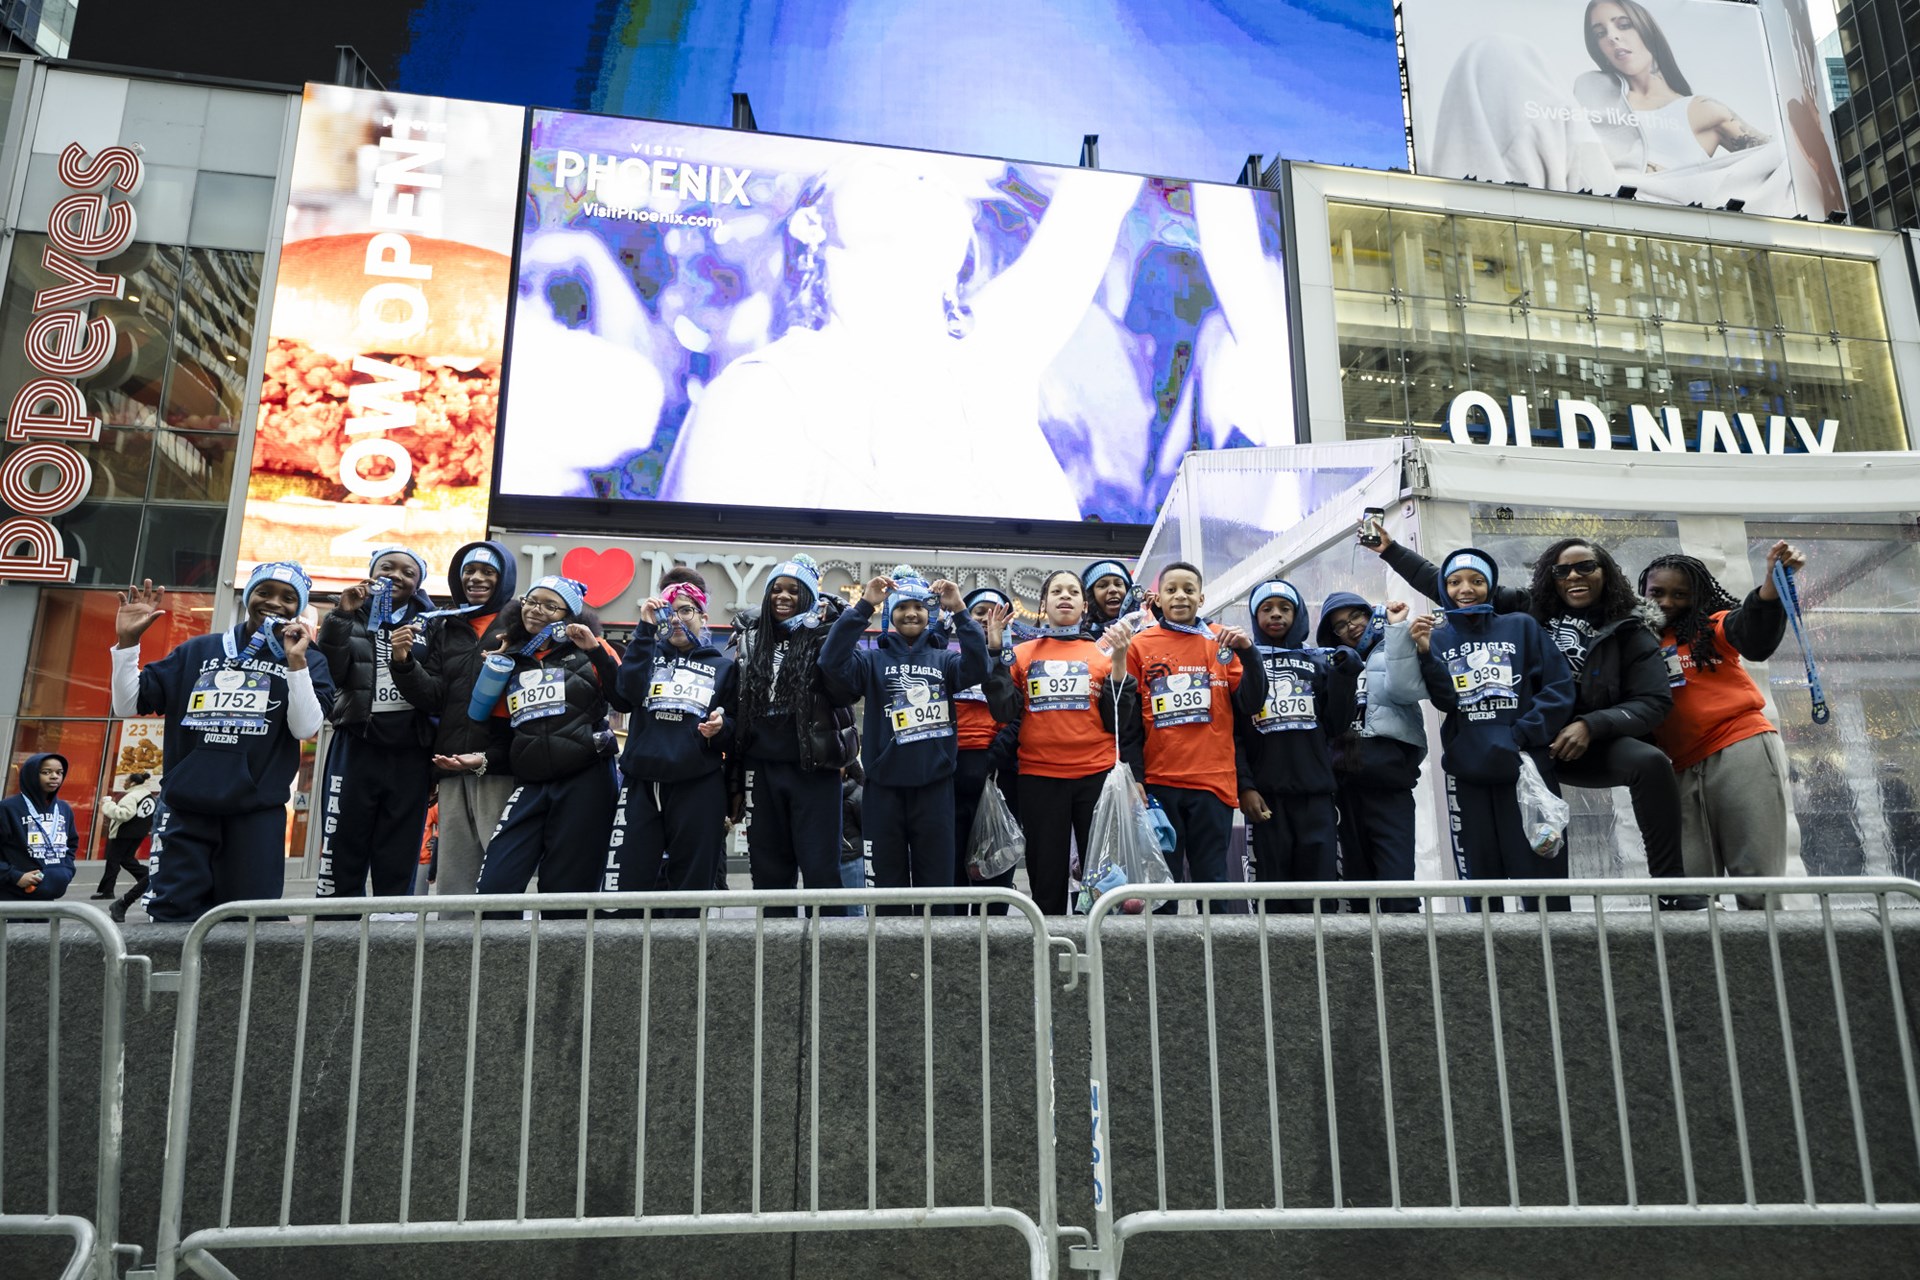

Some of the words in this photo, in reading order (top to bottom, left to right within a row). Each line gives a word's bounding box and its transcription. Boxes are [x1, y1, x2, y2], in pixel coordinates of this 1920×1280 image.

[1524, 100, 1601, 123] Sweats
[1607, 107, 1639, 127] like
[631, 143, 686, 158] VISIT
[555, 150, 752, 206] PHOENIX
[583, 202, 723, 228] VisitPhoenix.com
[359, 136, 446, 334] OPEN
[1628, 404, 1840, 454] NAVY
[330, 352, 421, 557] NOW
[636, 550, 779, 612] NY
[1460, 642, 1472, 656] 59
[1473, 641, 1516, 655] EAGLES
[241, 658, 288, 680] EAGLES
[678, 657, 716, 677] EAGLES
[885, 665, 899, 676] I.S.
[899, 664, 910, 674] 59
[911, 665, 943, 680] EAGLES
[1276, 658, 1315, 673] EAGLES
[1030, 681, 1038, 695] F
[1049, 678, 1077, 693] 937
[1455, 675, 1466, 688] E
[1473, 667, 1500, 683] 939
[193, 693, 204, 709] F
[213, 692, 256, 709] 1752
[511, 696, 518, 711] E
[520, 686, 556, 704] 1870
[653, 684, 662, 695] E
[673, 684, 700, 699] 941
[1156, 698, 1164, 711] F
[1173, 691, 1202, 708] 936
[1490, 698, 1519, 709] FIELD
[655, 710, 684, 721] QUEENS
[896, 712, 905, 727] F
[915, 704, 941, 722] 942
[1468, 711, 1497, 722] QUEENS
[203, 733, 239, 744] QUEENS
[296, 794, 306, 805] A
[316, 775, 343, 896] EAGLES
[1446, 774, 1468, 881] EAGLE
[31, 833, 38, 843] F
[602, 787, 628, 912] EAGLE
